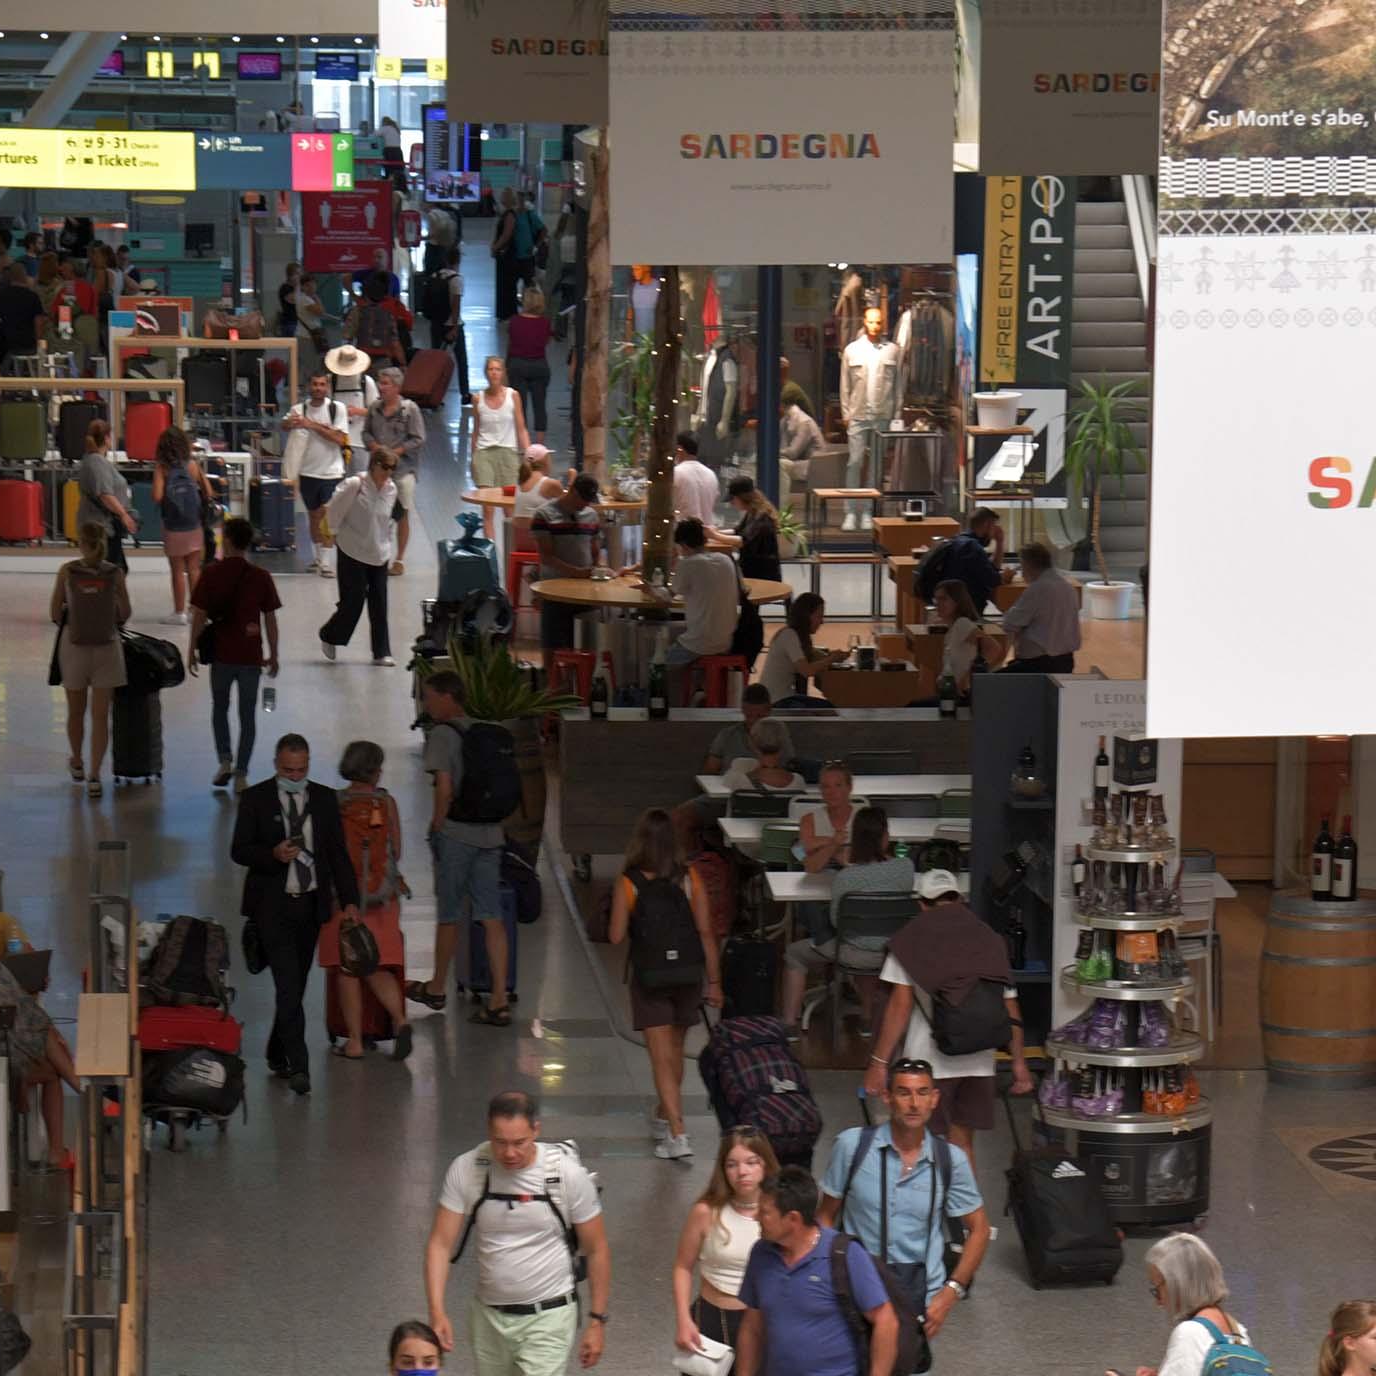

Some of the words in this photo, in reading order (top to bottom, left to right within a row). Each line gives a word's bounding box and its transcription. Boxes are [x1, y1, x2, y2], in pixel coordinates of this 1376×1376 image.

[491, 38, 609, 56] SARDEGN
[1206, 109, 1232, 127] Su
[1236, 109, 1306, 127] Mont'e
[1311, 108, 1369, 128] s'abe,
[679, 133, 881, 159] SARDEGNA
[98, 154, 138, 168] Ticket
[1001, 193, 1016, 223] TO
[998, 229, 1016, 299] ENTRY
[996, 305, 1013, 360] FREE
